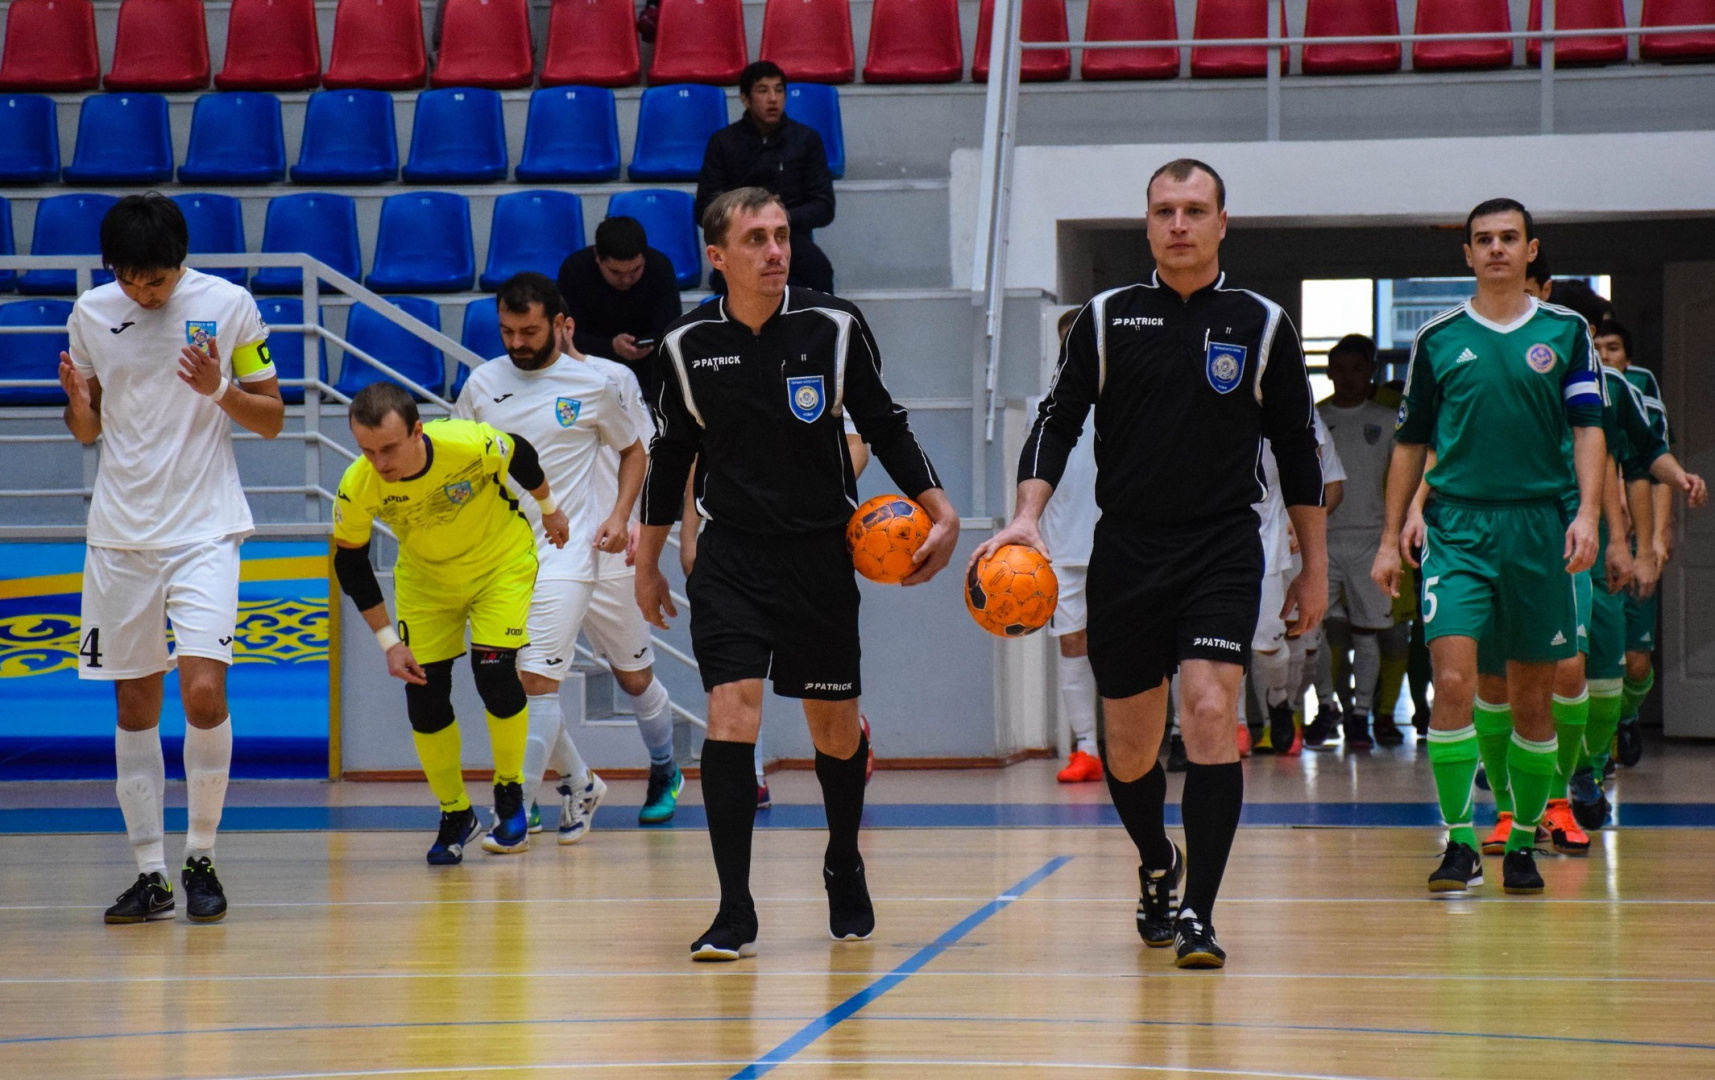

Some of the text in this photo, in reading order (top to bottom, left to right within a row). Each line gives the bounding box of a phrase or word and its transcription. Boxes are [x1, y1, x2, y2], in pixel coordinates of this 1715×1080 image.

[1123, 317, 1164, 326] PATRICK
[701, 355, 741, 367] PATRICK
[1424, 575, 1439, 623] 5
[398, 620, 409, 647] 9
[79, 628, 103, 668] 4
[1202, 637, 1242, 653] PATRICK
[814, 682, 853, 692] PATRICK
